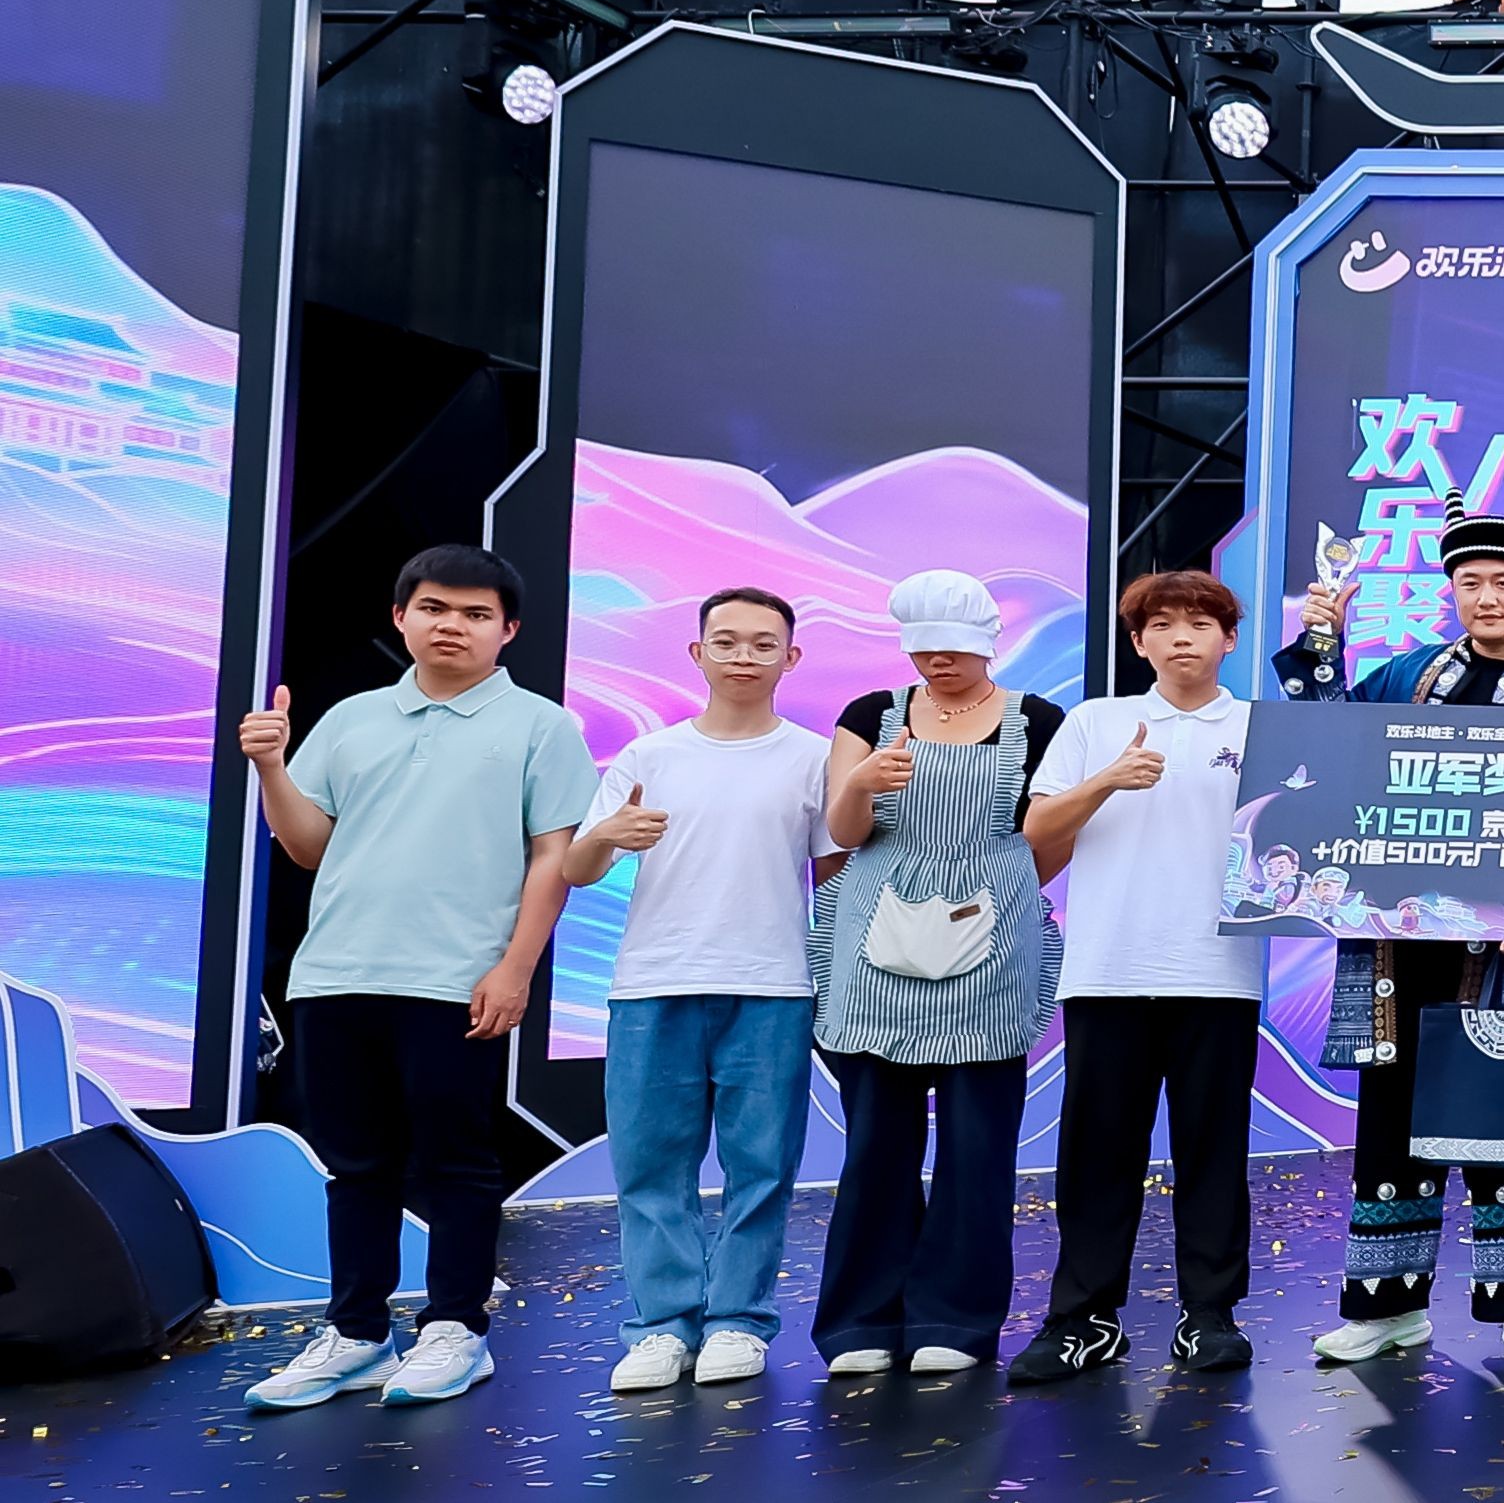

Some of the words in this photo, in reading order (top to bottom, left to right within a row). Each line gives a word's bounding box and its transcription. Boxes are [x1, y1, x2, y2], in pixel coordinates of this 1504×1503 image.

[1348, 393, 1464, 688] 欢乐聚
[1354, 805, 1471, 838] ¥1500
